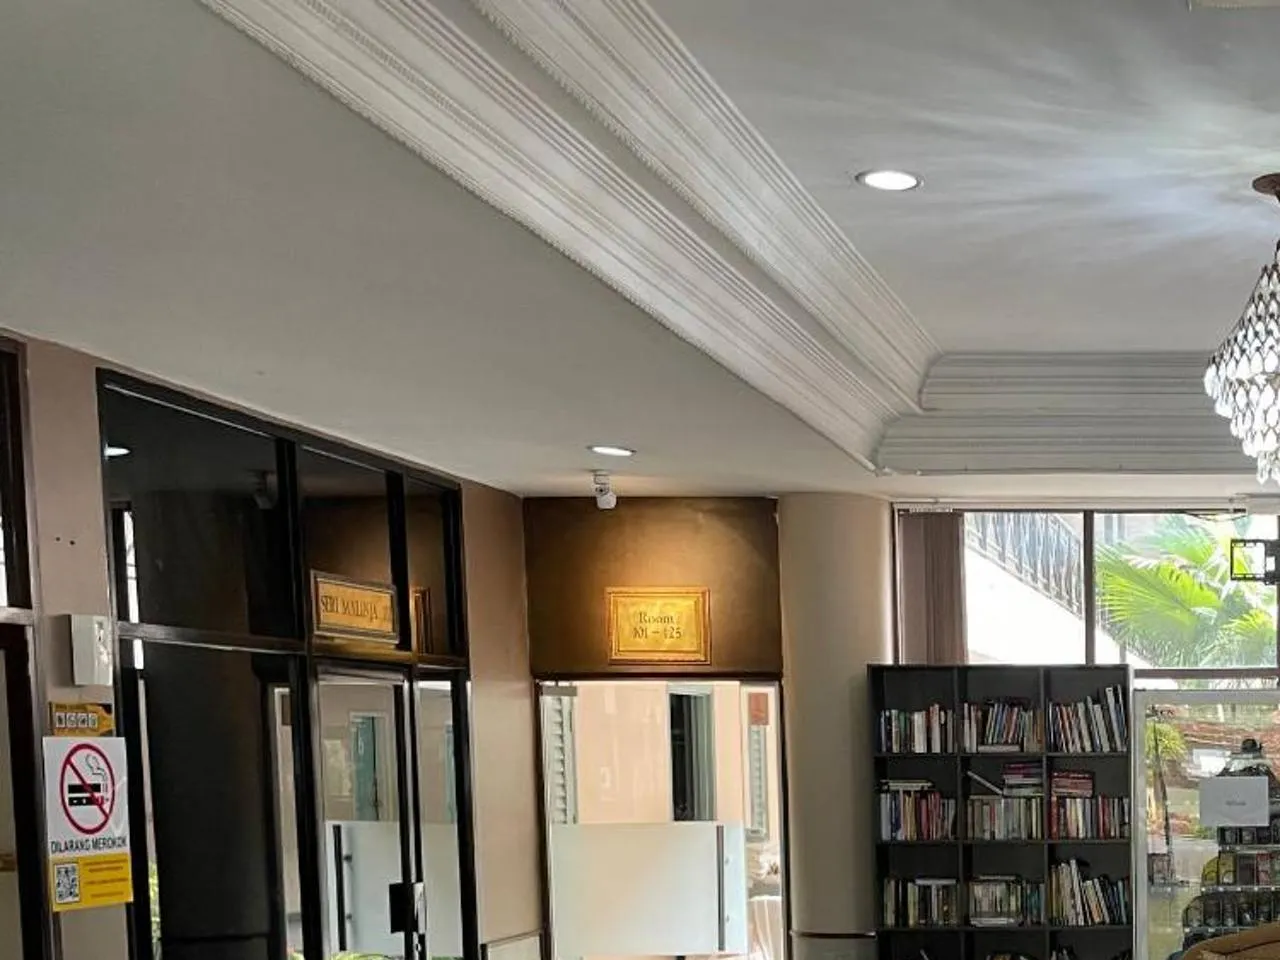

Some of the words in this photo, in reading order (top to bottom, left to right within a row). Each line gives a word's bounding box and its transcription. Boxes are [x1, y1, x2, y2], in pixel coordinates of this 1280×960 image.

[320, 595, 340, 614] SERI
[639, 611, 675, 624] Room
[663, 627, 682, 640] 125
[51, 838, 91, 854] DILARANG
[91, 836, 128, 851] MEROKOK
